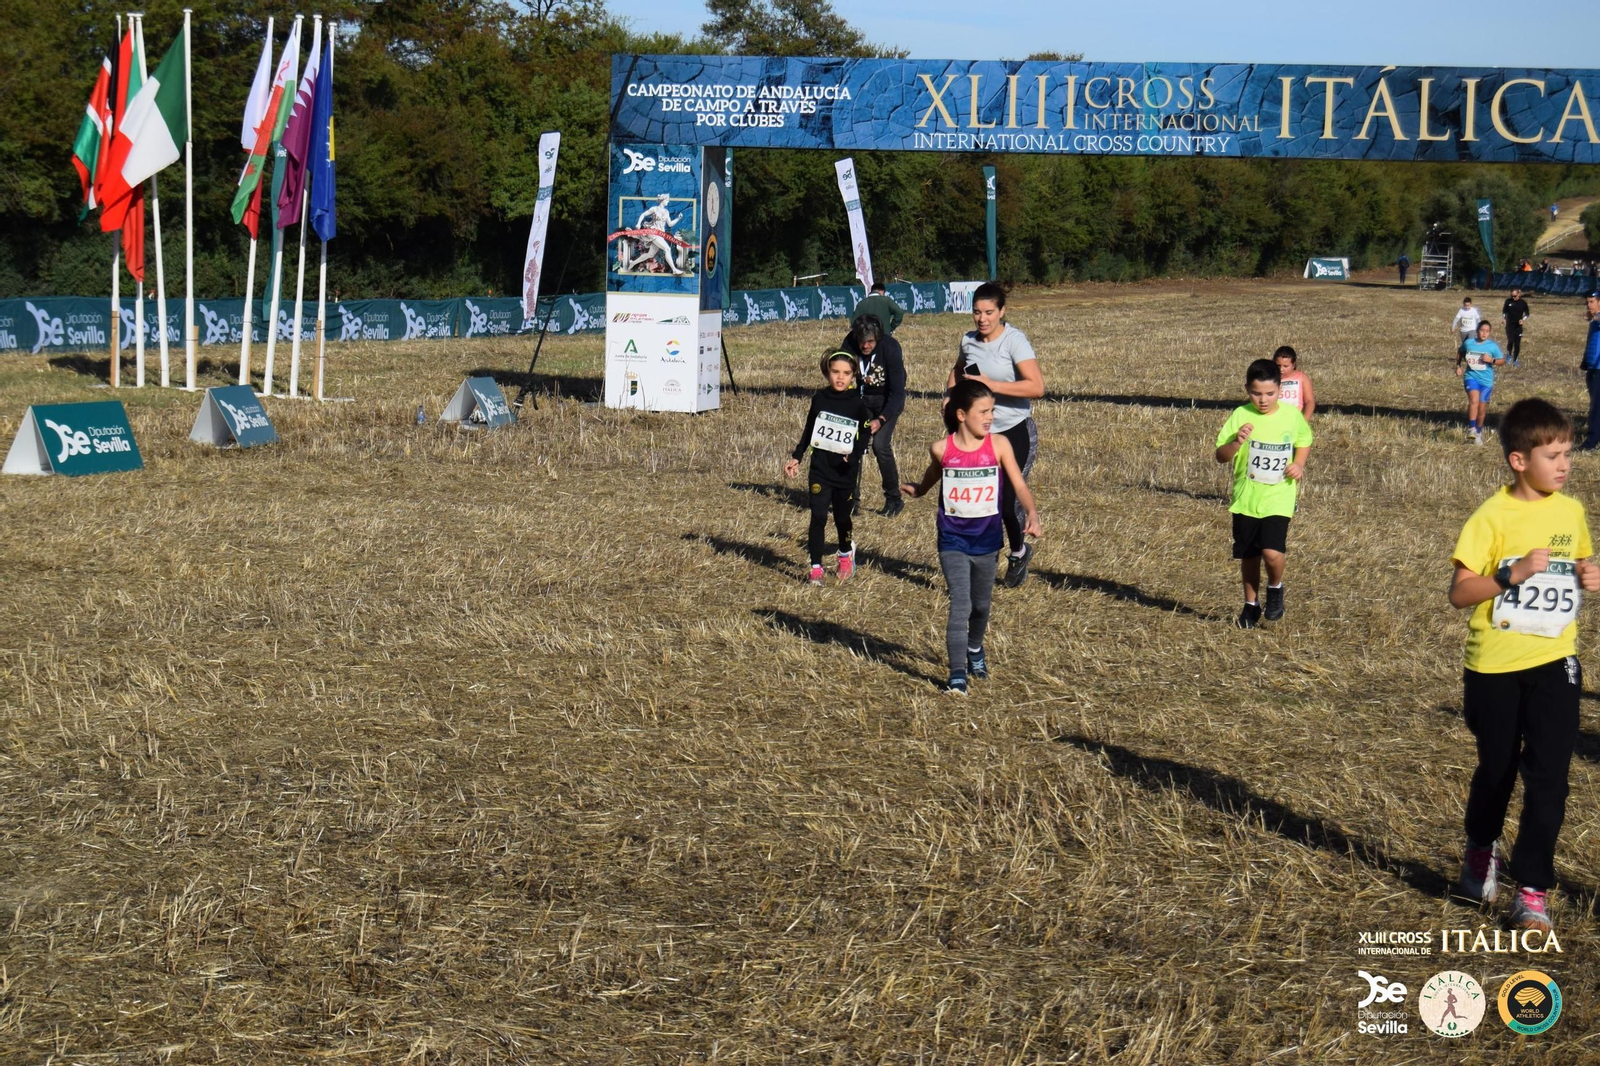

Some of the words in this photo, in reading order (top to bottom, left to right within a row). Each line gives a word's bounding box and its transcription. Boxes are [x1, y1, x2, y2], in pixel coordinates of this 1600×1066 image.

[627, 83, 733, 98] CAMPEONATO
[735, 84, 756, 99] DE
[759, 84, 851, 100] ANDALUCÍA
[662, 99, 681, 112] DE
[684, 99, 735, 113] CAMPO
[743, 100, 756, 113] A
[758, 98, 816, 114] TRAVÉS
[915, 74, 1080, 130] XLIII
[1084, 76, 1216, 110] CROSS
[1276, 65, 1600, 144] ITÁLICA
[696, 113, 727, 127] POR
[729, 114, 784, 128] CLUBES
[1083, 112, 1264, 132] INTERNACIONAL
[914, 132, 1069, 151] INTERNATIONAL
[1073, 135, 1133, 152] CROSS
[1137, 135, 1230, 153] COUNTRY
[658, 155, 692, 163] Diputación
[658, 162, 691, 173] Sevilla
[67, 325, 105, 345] Sevilla
[362, 325, 389, 340] Sevilla
[248, 414, 268, 428] Sevilla
[90, 425, 125, 438] Diputación
[817, 425, 852, 444] 4218
[93, 438, 131, 454] Sevilla
[948, 485, 995, 503] 4472
[1496, 585, 1574, 613] 4295
